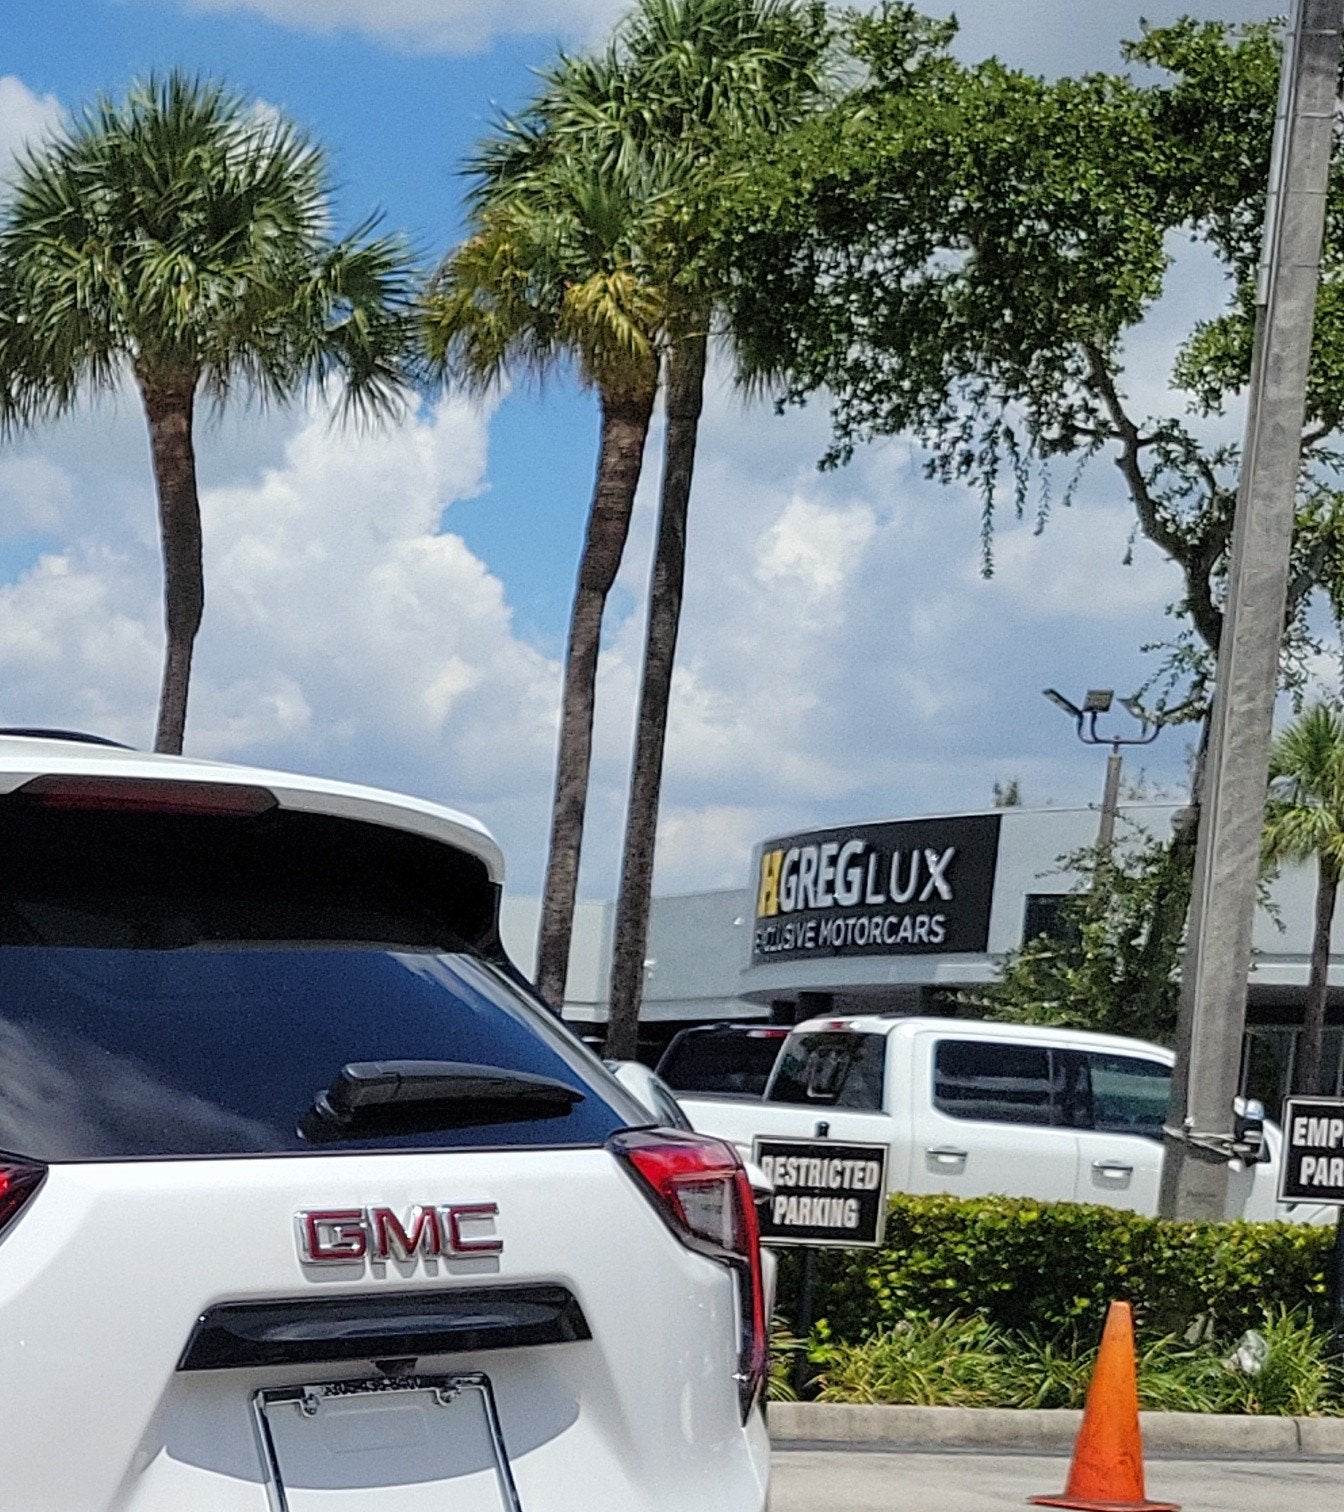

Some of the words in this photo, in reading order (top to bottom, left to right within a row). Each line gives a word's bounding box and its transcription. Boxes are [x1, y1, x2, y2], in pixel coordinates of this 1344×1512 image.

[818, 914, 947, 947] MOTORCARS
[1292, 1117, 1344, 1148] EMP
[761, 1154, 881, 1190] RESTRICTED
[773, 1195, 859, 1229] PARKING
[293, 1202, 503, 1264] GMC
